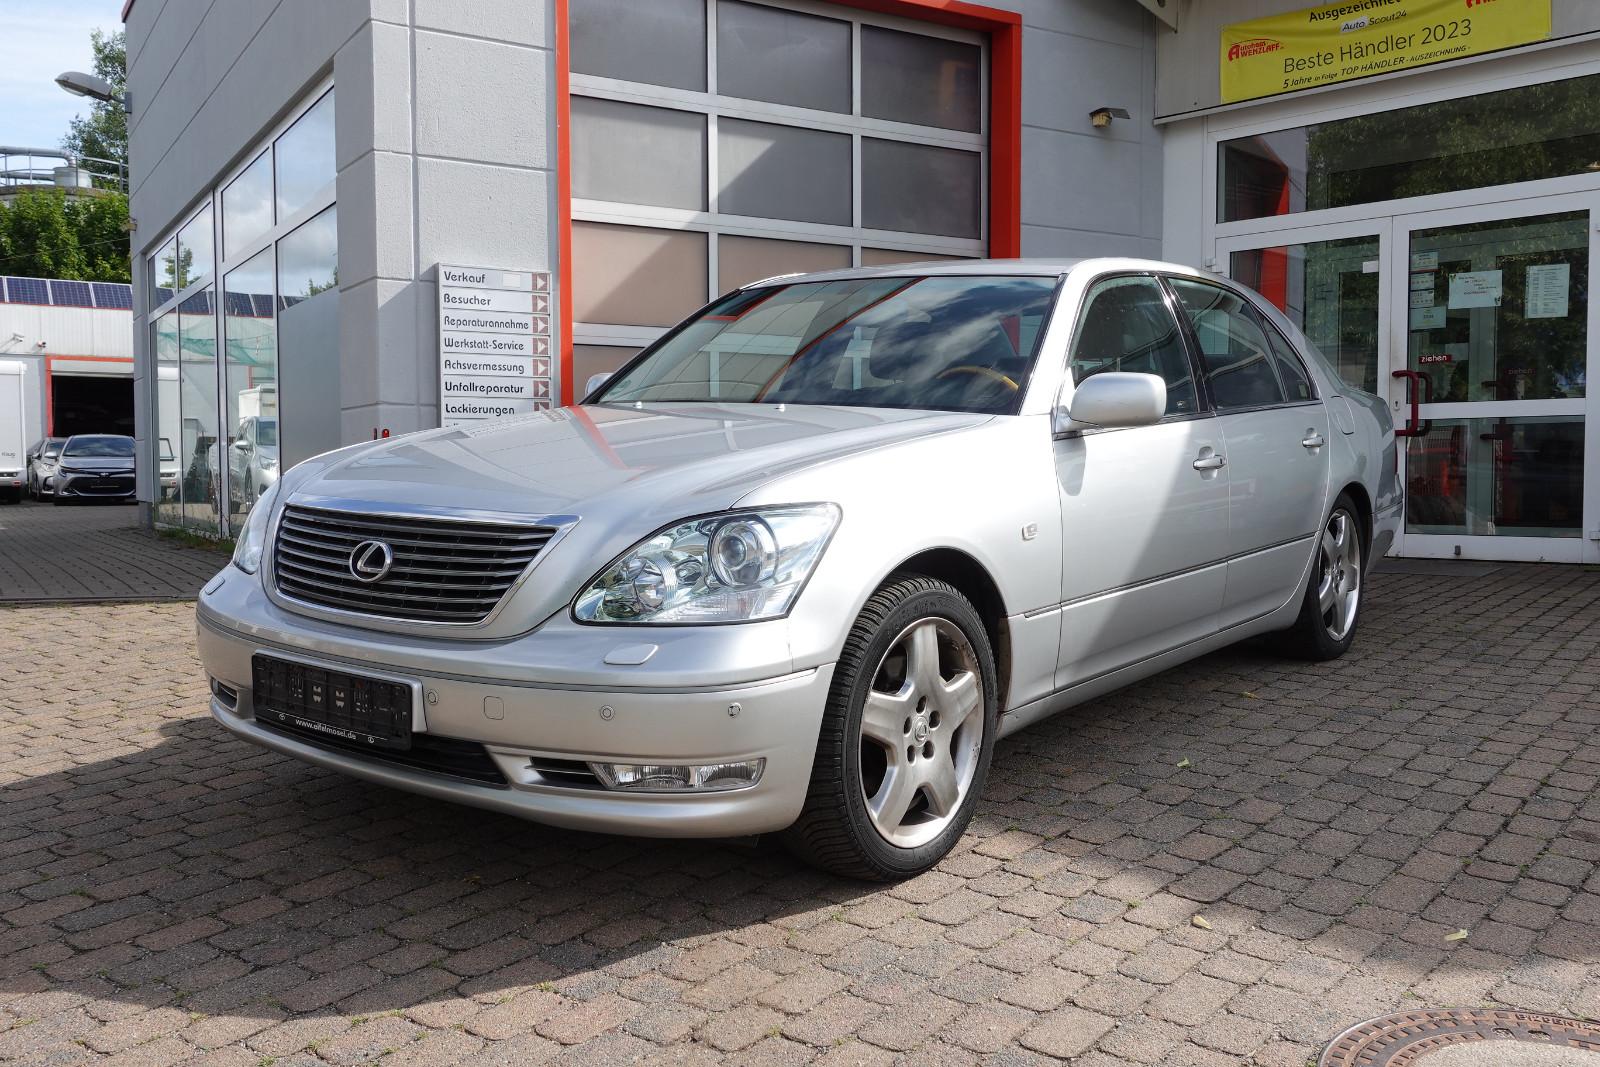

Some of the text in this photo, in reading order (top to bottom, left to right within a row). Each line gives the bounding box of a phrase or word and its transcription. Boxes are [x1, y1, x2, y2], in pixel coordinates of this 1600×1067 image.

[1309, 0, 1401, 23] Ausgezeichne
[1342, 10, 1407, 32] Auto Scout24
[1240, 43, 1280, 57] WENZLAFF
[1284, 18, 1471, 74] Beste Händler 2023
[1282, 79, 1289, 88] 5
[1290, 76, 1312, 86] Jahre
[1321, 72, 1338, 80] Folge
[1341, 66, 1359, 76] TOP
[1360, 57, 1405, 72] HÄNDLER
[1409, 45, 1467, 62] AUSZEICHNUNG
[444, 271, 486, 283] Verkauf
[443, 293, 491, 306] Besucher
[444, 315, 529, 330] Reparaturannahme
[444, 337, 525, 350] Werkstatt-Service
[1421, 354, 1447, 363] ziehen
[444, 360, 525, 375] Achsvermessung
[445, 381, 524, 395] Unfallreparatur
[445, 403, 515, 417] Lackierungen
[295, 719, 357, 740] www.eifelmosel.de
